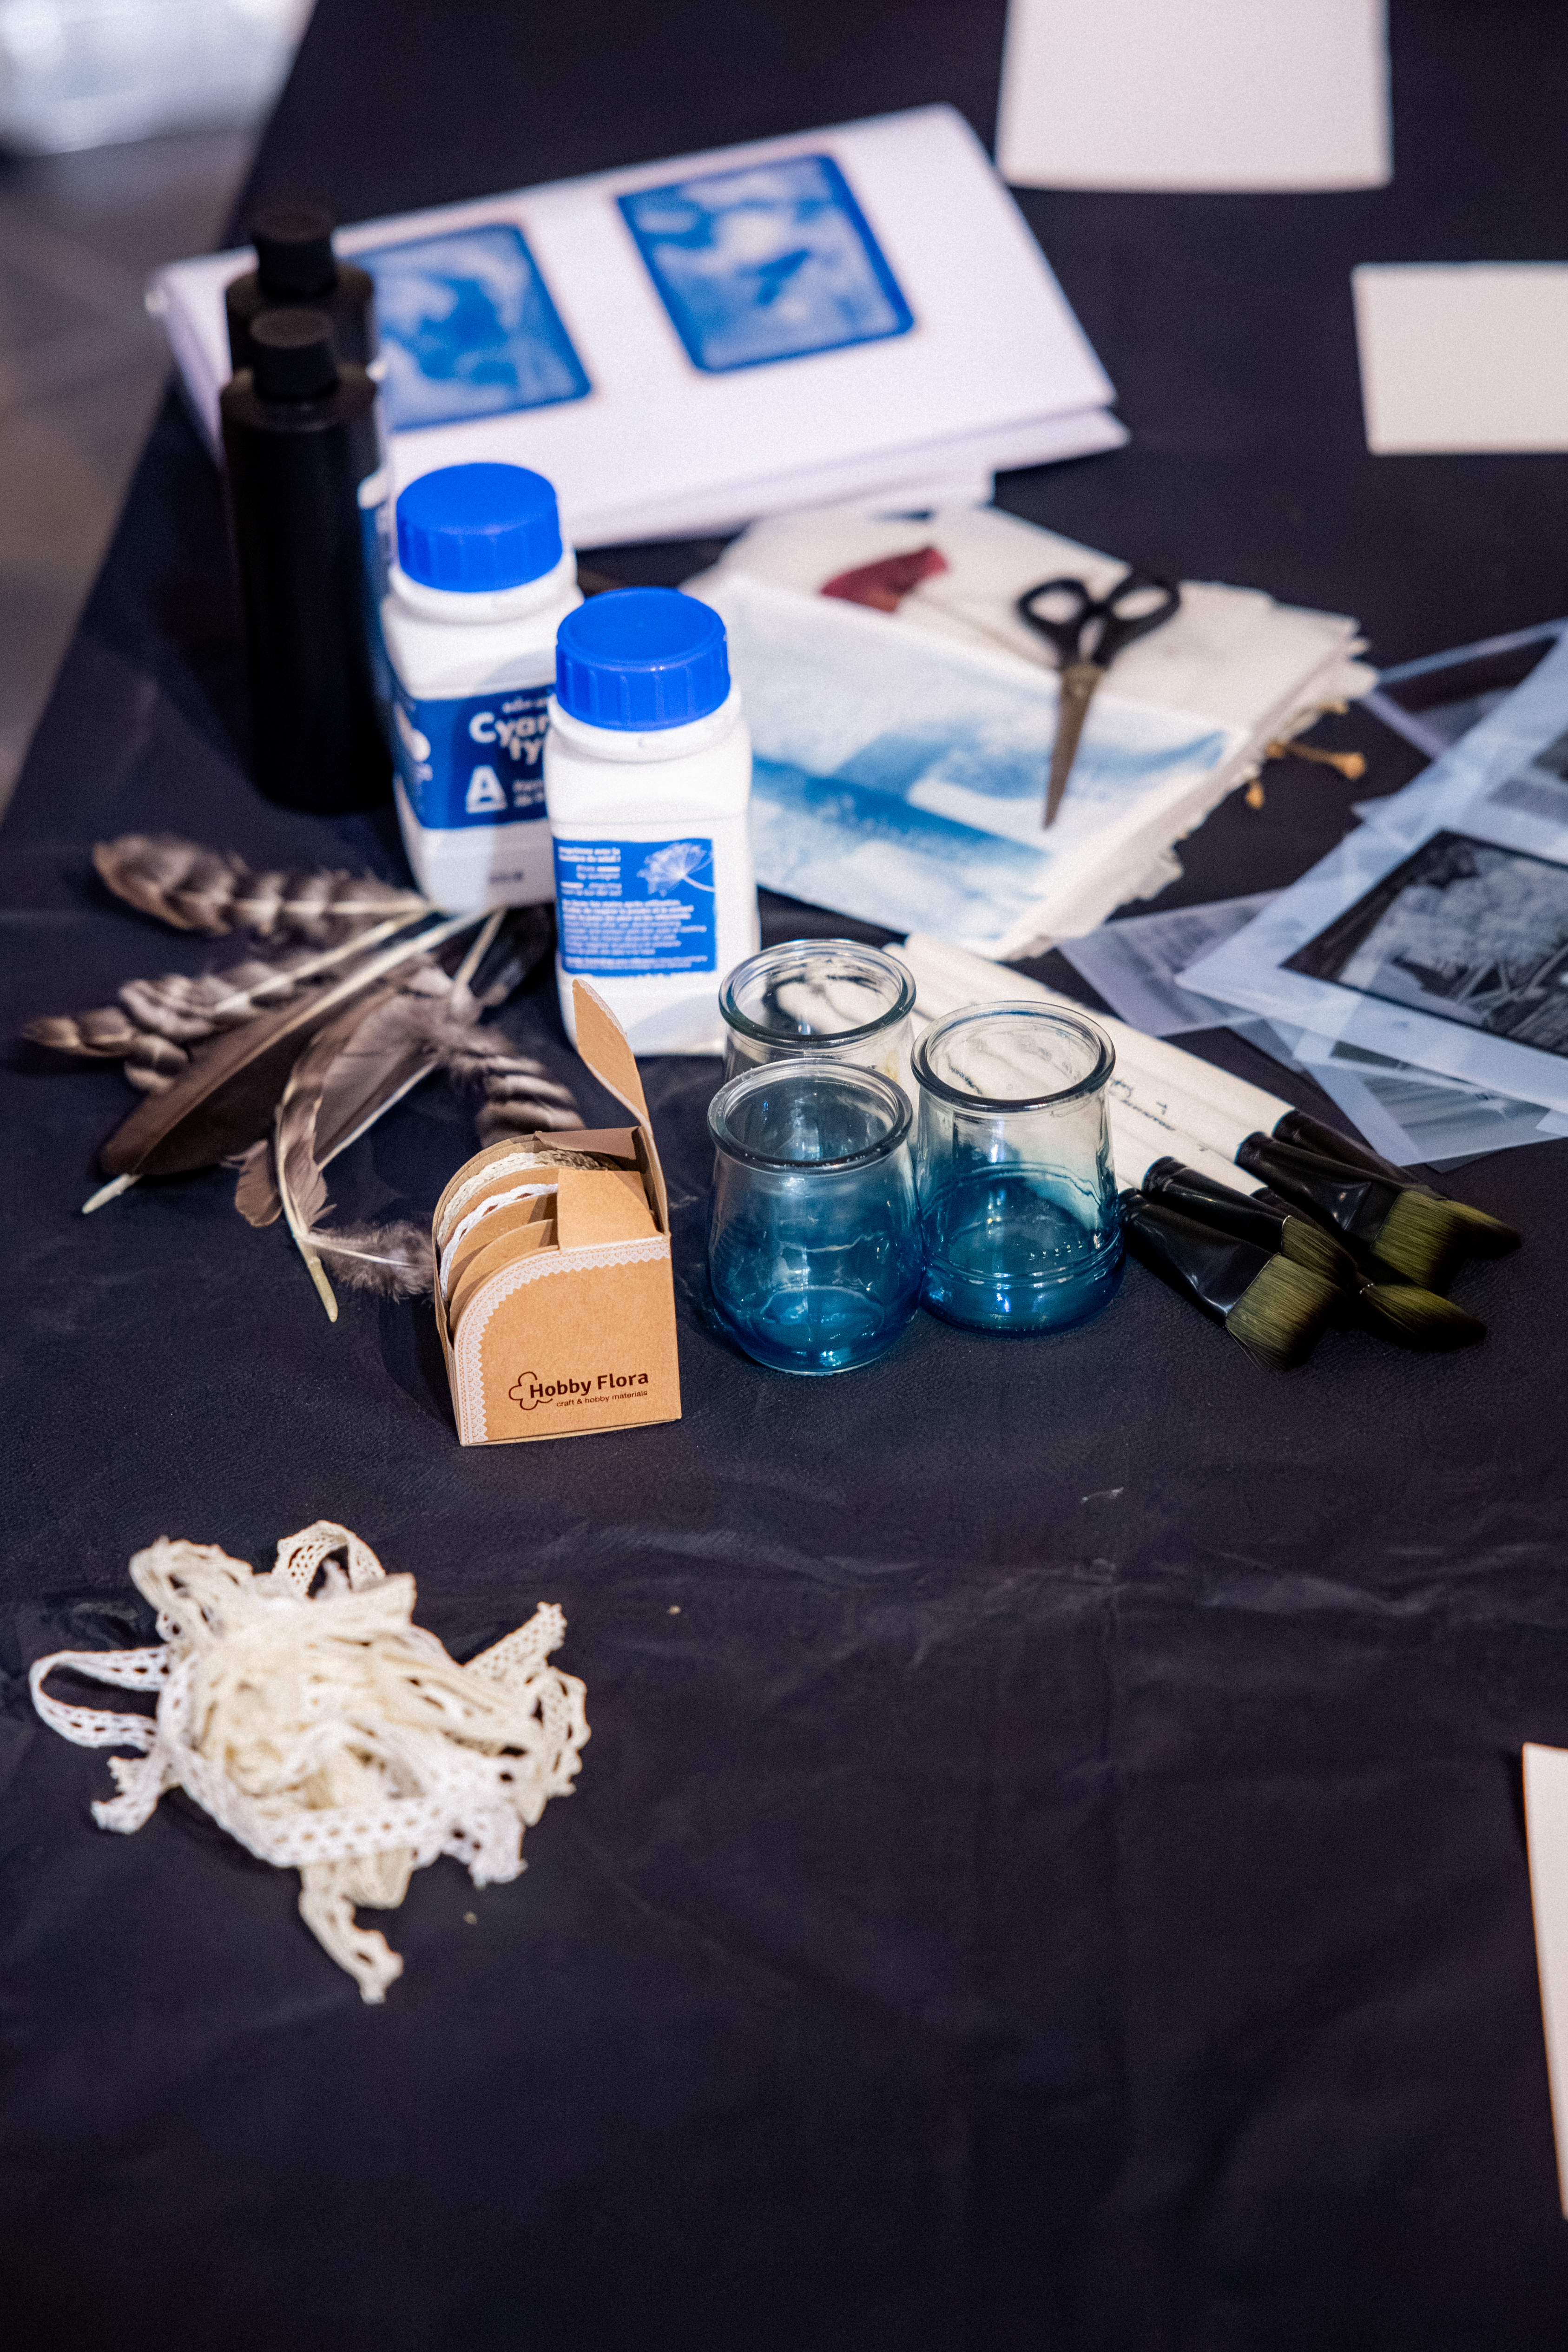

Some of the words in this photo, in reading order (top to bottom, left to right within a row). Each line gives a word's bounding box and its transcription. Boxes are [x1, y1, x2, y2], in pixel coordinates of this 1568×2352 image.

[466, 765, 508, 814] A
[530, 1378, 592, 1398] Hobby
[597, 1373, 649, 1390] Flora
[612, 1390, 648, 1400] materials
